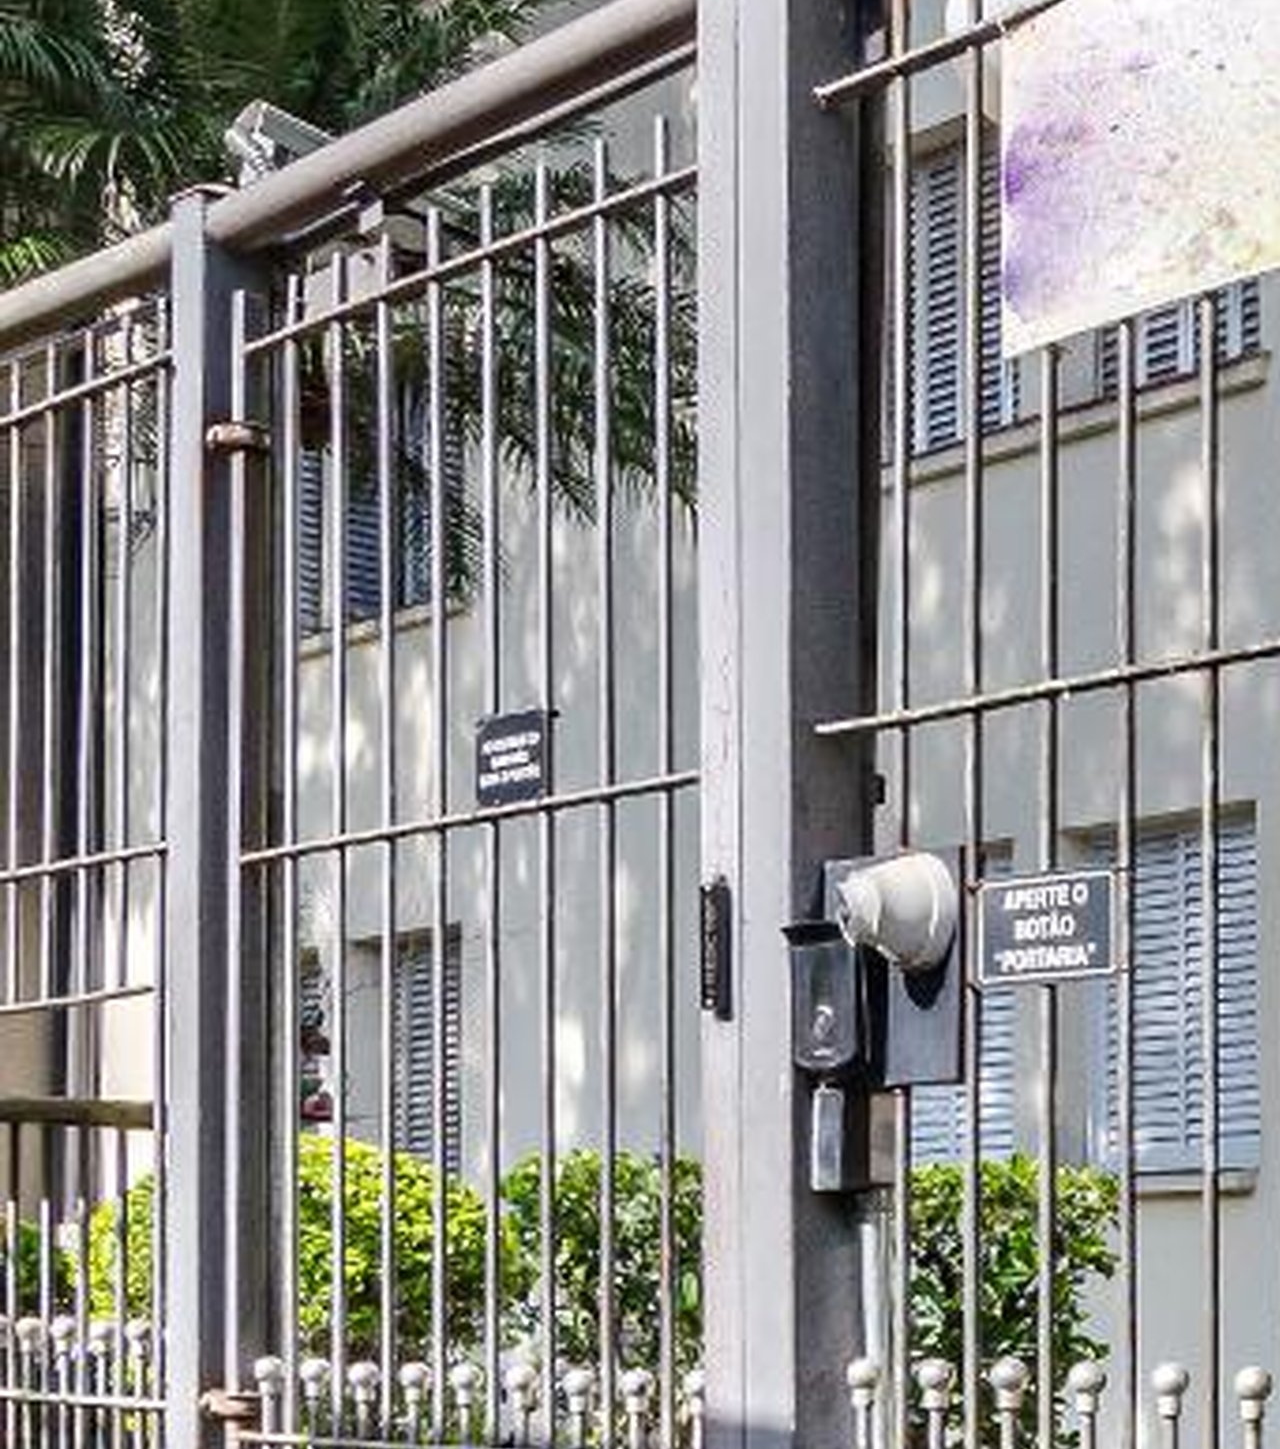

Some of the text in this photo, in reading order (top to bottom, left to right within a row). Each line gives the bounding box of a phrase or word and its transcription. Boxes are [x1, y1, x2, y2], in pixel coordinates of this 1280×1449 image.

[1003, 882, 1089, 910] APERTE O
[1013, 911, 1076, 941] BOTÃO
